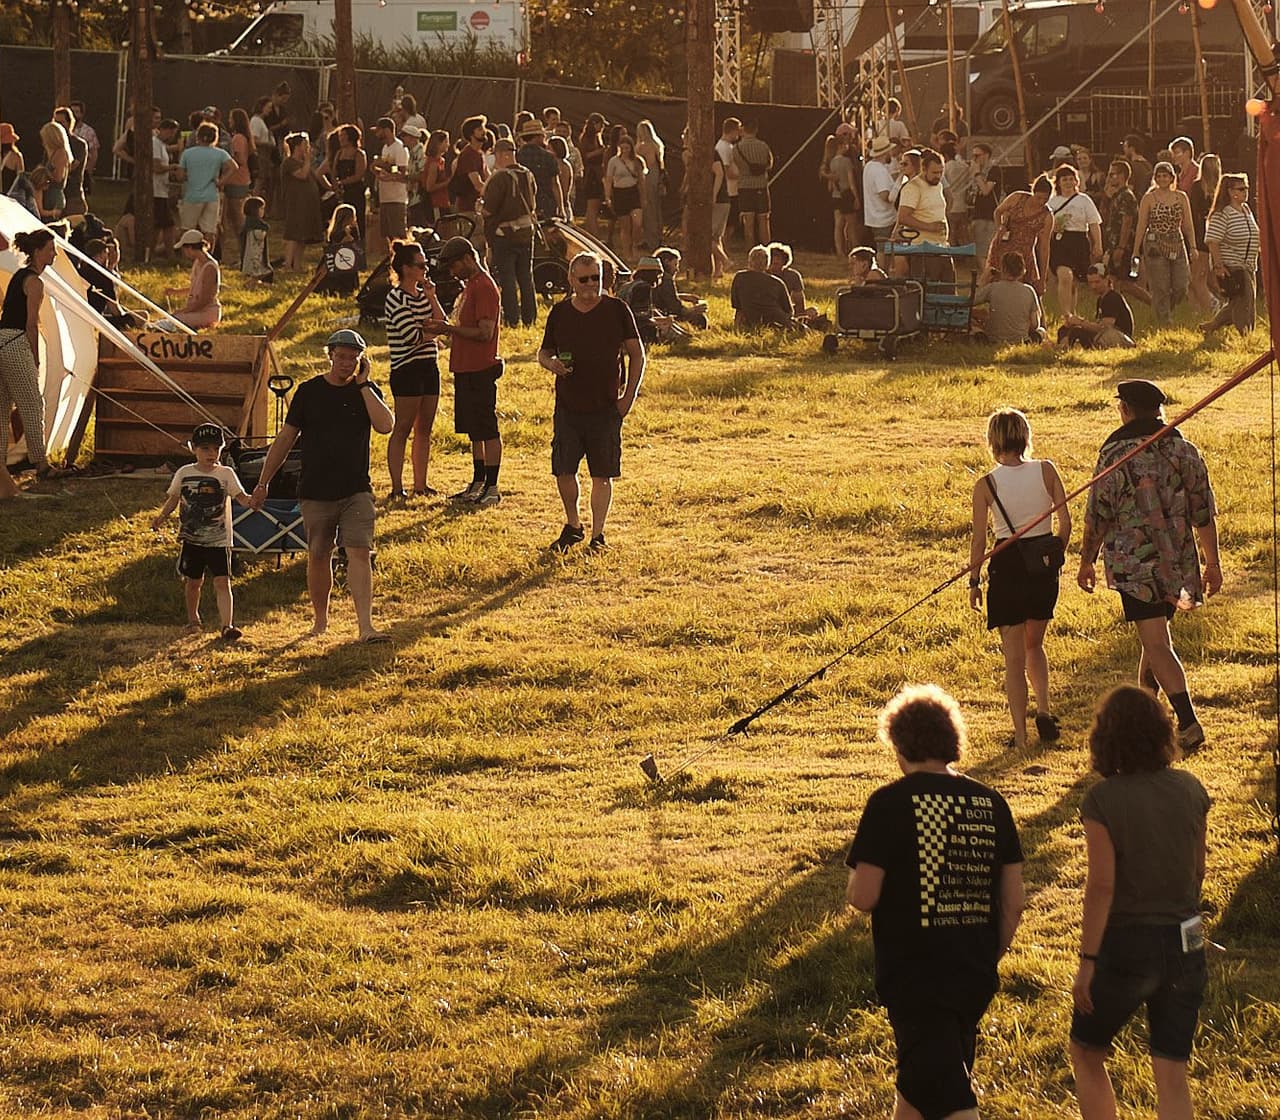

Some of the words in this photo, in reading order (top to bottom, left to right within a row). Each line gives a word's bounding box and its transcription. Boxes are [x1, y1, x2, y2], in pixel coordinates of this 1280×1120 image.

[136, 333, 213, 359] Schuhe
[971, 796, 993, 808] SOS
[965, 809, 993, 821] BOTT
